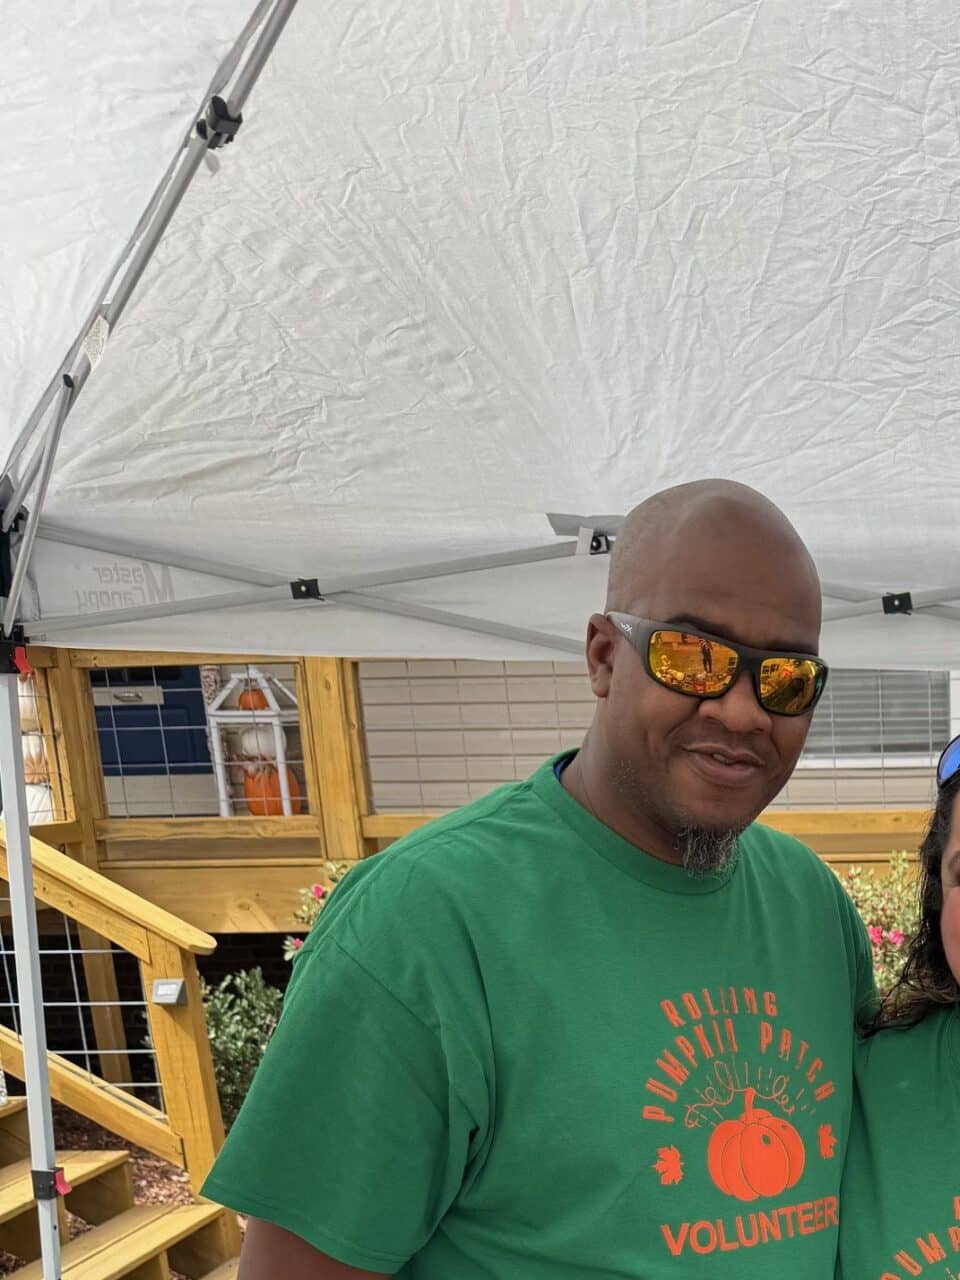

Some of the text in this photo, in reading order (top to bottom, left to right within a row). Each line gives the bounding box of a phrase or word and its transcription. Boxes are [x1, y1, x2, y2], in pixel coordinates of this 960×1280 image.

[660, 986, 777, 1027] ROLLING
[760, 1021, 835, 1101] PATCH
[661, 1196, 838, 1256] VOLUNTEER
